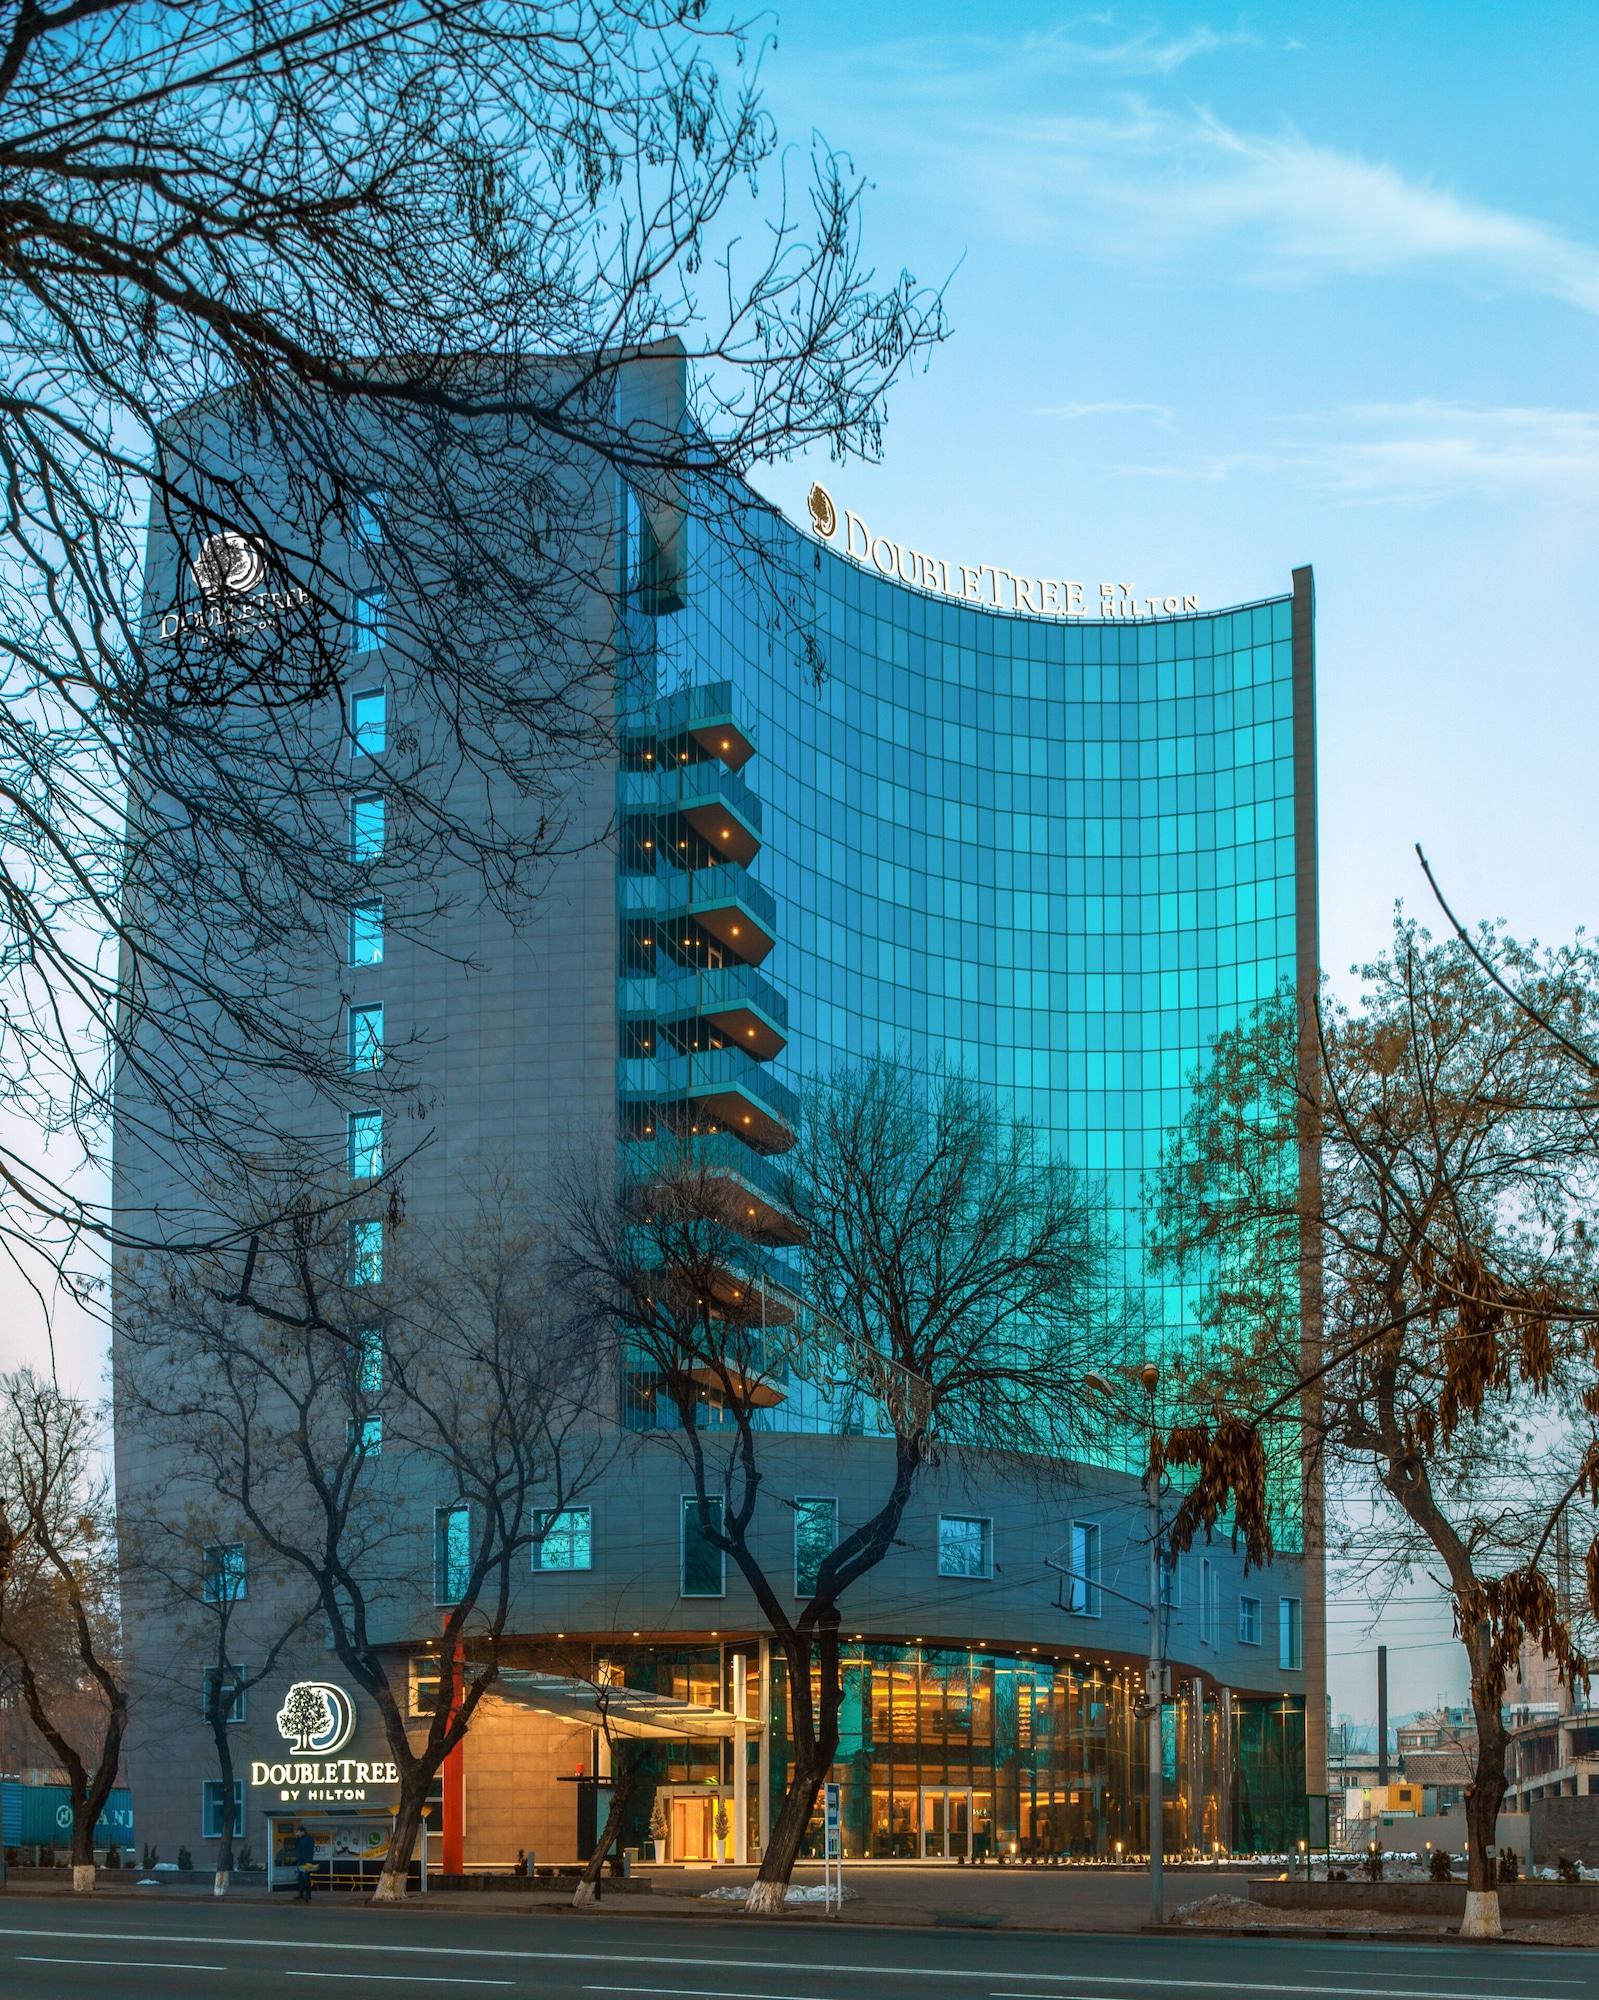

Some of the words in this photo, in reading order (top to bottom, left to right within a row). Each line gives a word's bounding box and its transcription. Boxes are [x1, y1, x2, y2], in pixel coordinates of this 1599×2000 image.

[844, 509, 1089, 617] DOUBLETREE
[1099, 582, 1136, 597] BY
[1100, 593, 1199, 617] HILTON
[251, 1759, 400, 1786] DOUBLETREE
[280, 1789, 301, 1801] BY
[308, 1789, 366, 1801] HILTON
